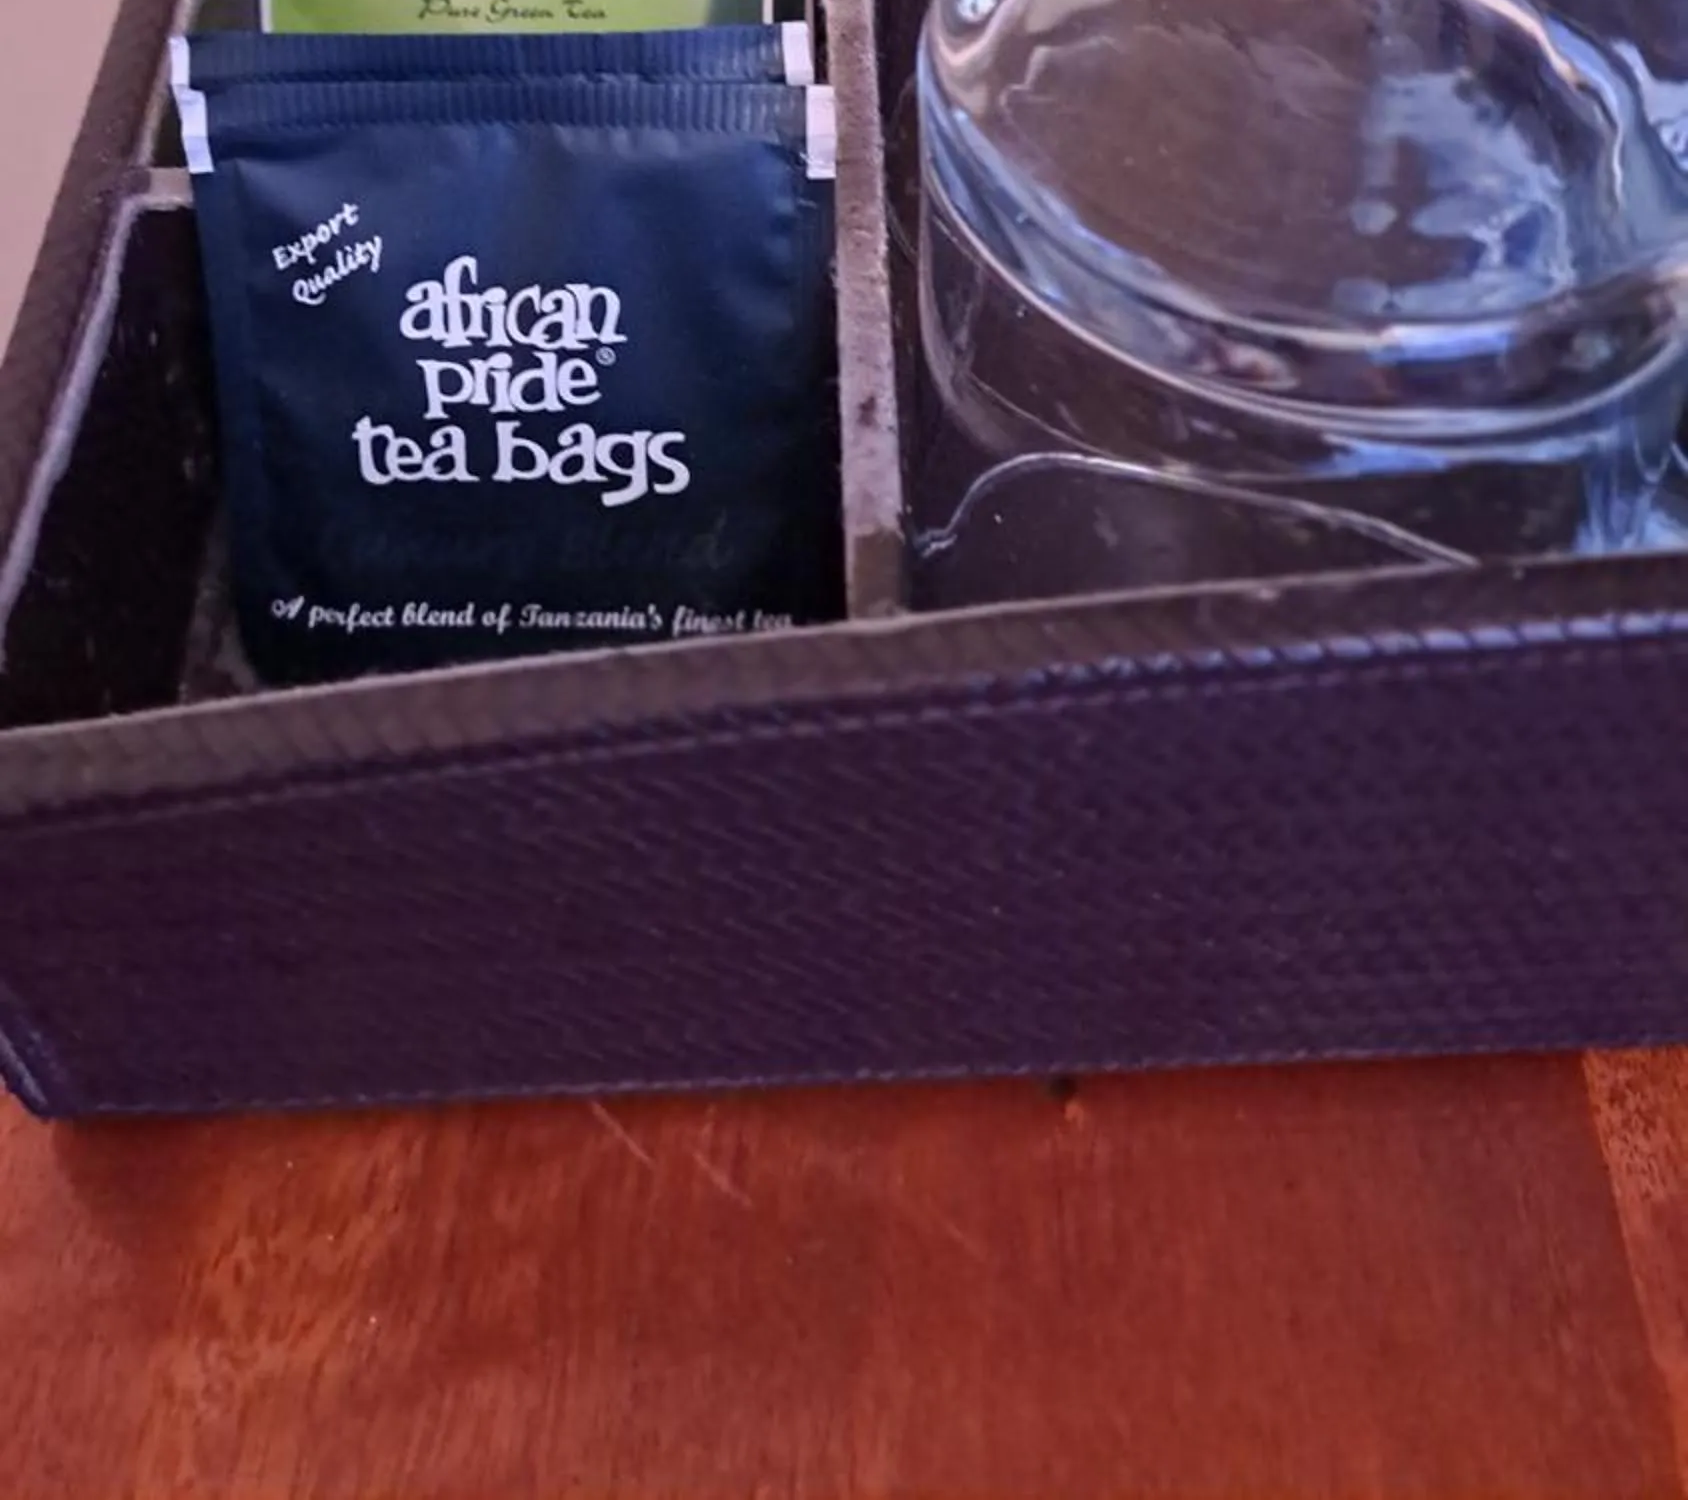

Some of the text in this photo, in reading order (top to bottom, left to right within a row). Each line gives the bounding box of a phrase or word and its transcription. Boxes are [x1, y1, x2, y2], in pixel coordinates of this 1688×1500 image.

[271, 202, 360, 271] Export
[291, 234, 383, 306] Quality
[399, 255, 628, 351] african
[351, 415, 692, 508] tea bags
[271, 595, 794, 638] A perfect blend of Tanzania's finest tea
